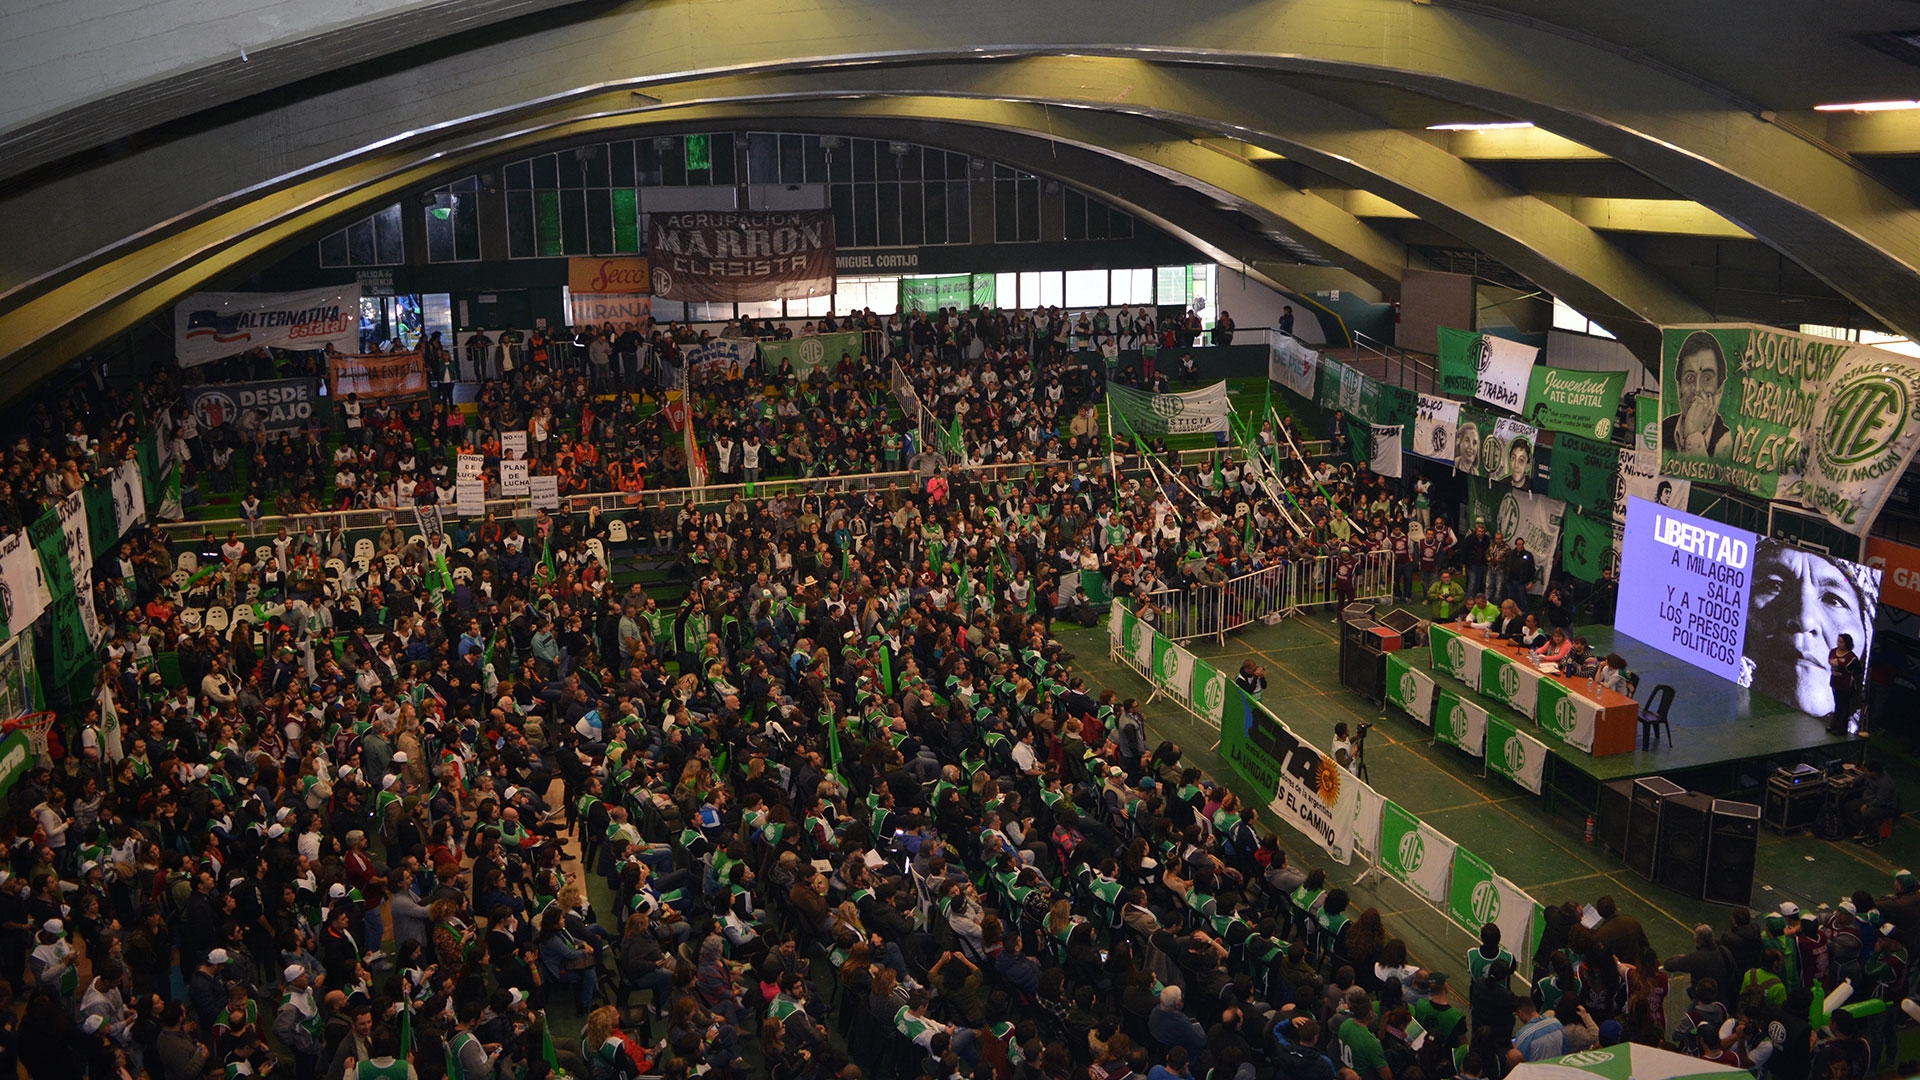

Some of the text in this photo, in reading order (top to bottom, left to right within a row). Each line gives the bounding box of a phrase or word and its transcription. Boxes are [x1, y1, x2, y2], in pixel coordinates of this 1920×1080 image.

[667, 213, 800, 228] AGRUPACION
[654, 220, 825, 259] MARRON
[591, 260, 645, 291] Secco
[673, 255, 807, 276] CLASISTA
[835, 254, 918, 268] MIGUEL CORTIJO
[239, 305, 339, 329] ALTERNATIVA
[288, 313, 347, 339] estatal
[688, 342, 740, 364] CNEA
[802, 341, 822, 361] ATE
[1471, 343, 1488, 369] ATE
[240, 385, 307, 407] DESDE
[1483, 381, 1518, 406] TRABAJO
[1543, 370, 1610, 396] Juventud
[1549, 390, 1603, 408] ATE CAPITAL
[1596, 419, 1610, 438] ATE
[1829, 384, 1899, 457] ATE
[1654, 514, 1748, 569] LIBERTAD
[1670, 550, 1745, 589] A MILAGRO
[1666, 585, 1740, 628] Y A TODOS
[1707, 582, 1742, 610] SALA
[1659, 601, 1738, 647] LOS PRESOS
[1447, 638, 1466, 669] ATE
[1672, 625, 1736, 666] POLITICOS
[1163, 648, 1178, 677] ATE
[1204, 677, 1222, 709] ATE
[1400, 673, 1416, 703] ATE
[1500, 664, 1519, 695] ATE
[1450, 705, 1468, 737] ATE
[1557, 698, 1577, 731] ATE
[1505, 737, 1525, 770] ATE
[1231, 744, 1242, 765] LA
[1243, 759, 1273, 790] UNIDAD
[1274, 783, 1285, 801] ES
[1286, 791, 1298, 813] EL
[1300, 804, 1336, 847] CAMINO
[1399, 831, 1424, 872] ATE
[1472, 880, 1501, 924] ATE
[1769, 1021, 1786, 1043] ATE
